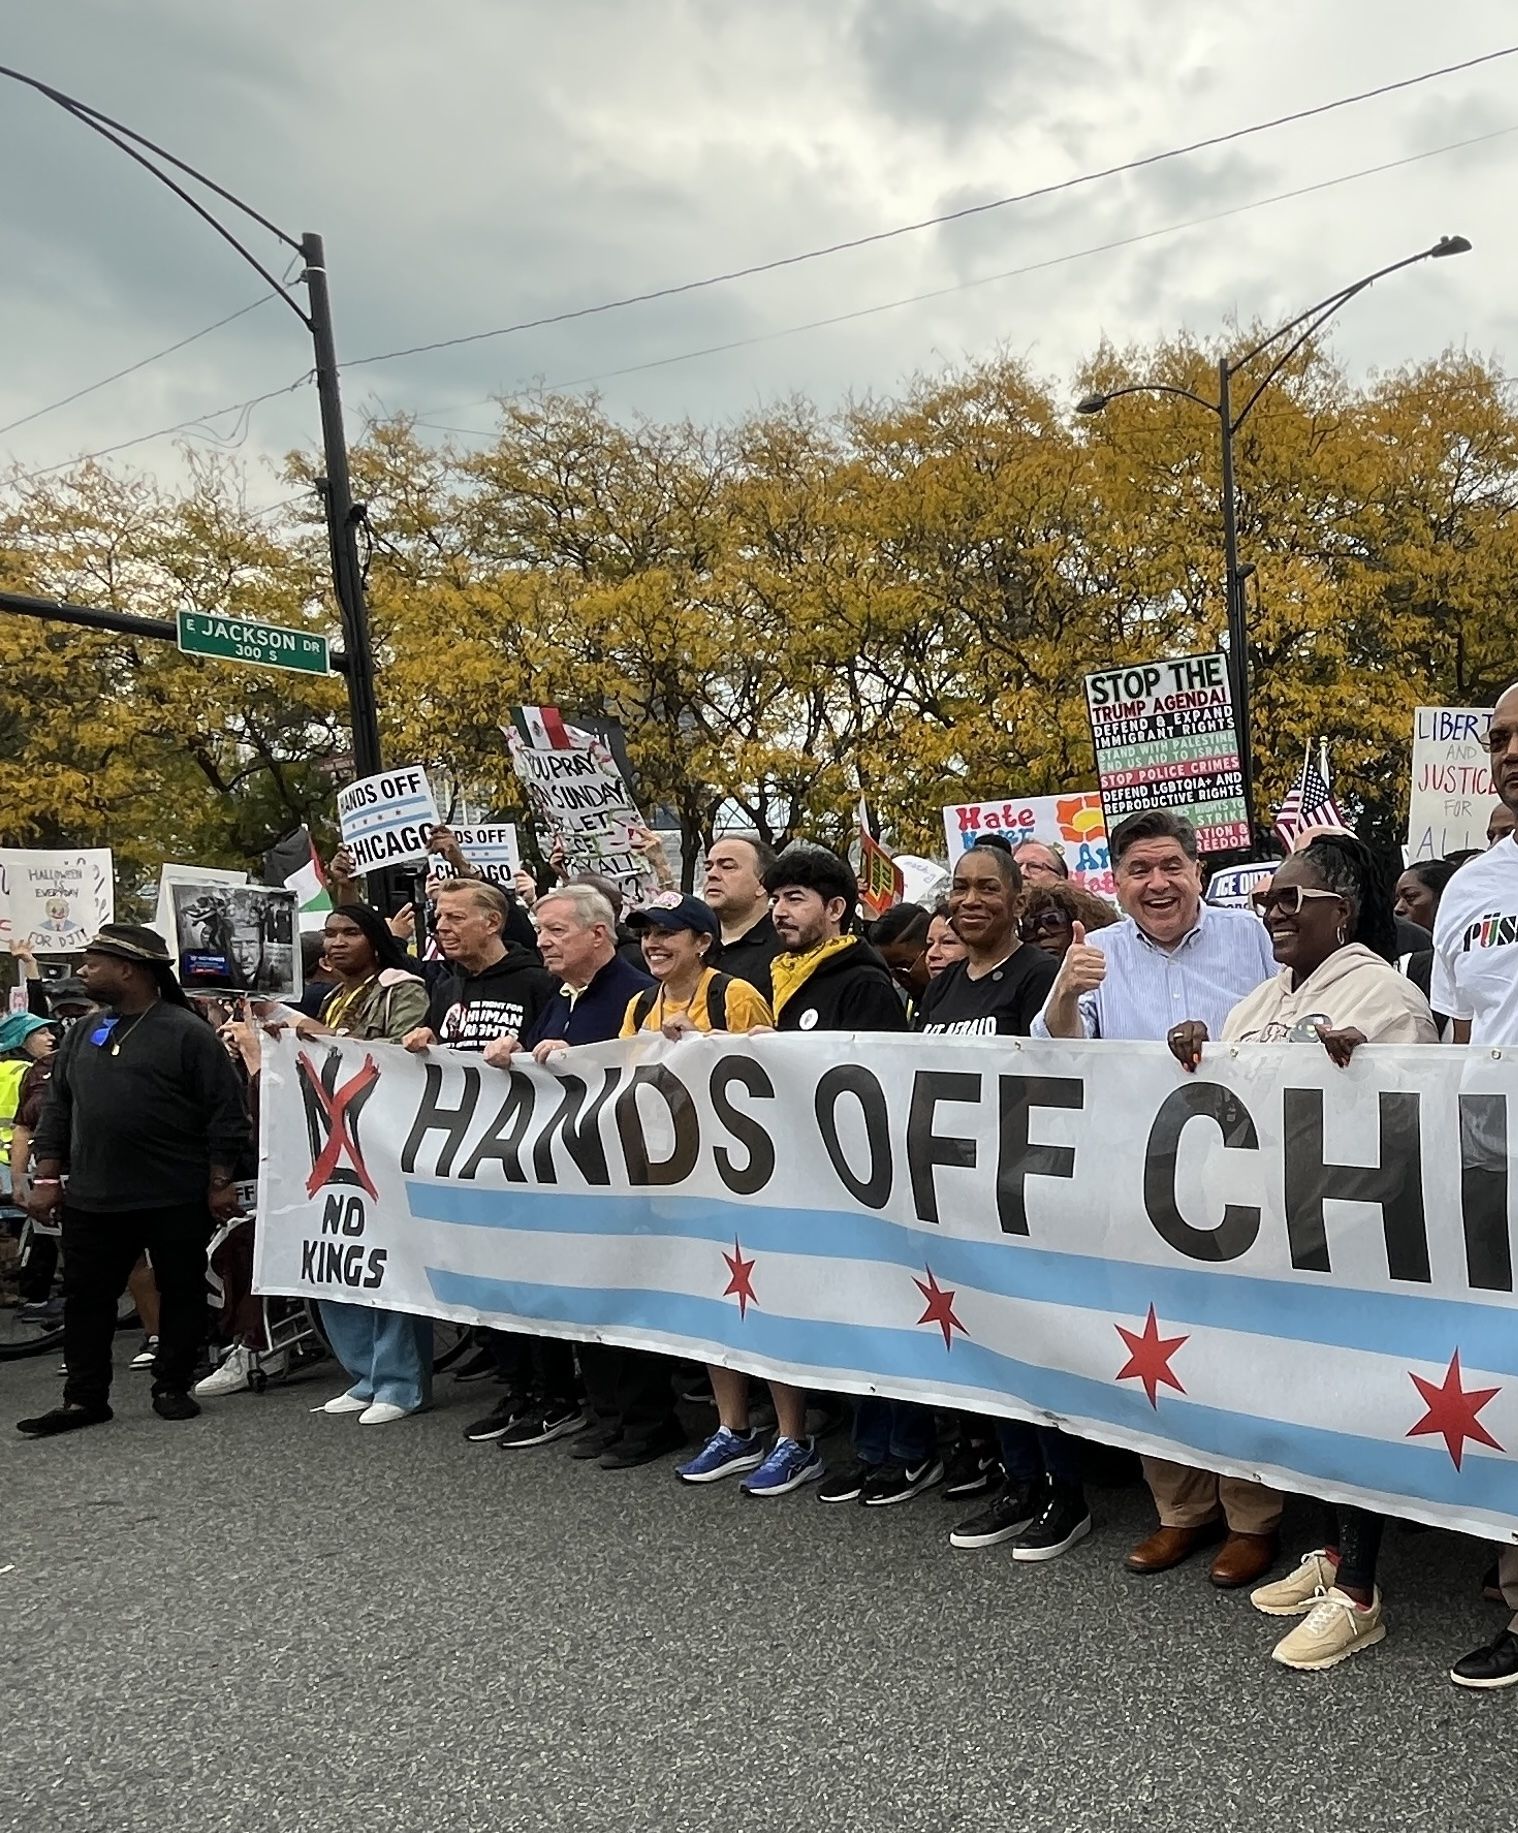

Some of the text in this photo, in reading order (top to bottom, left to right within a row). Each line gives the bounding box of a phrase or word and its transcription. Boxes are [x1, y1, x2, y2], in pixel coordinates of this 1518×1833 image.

[186, 618, 321, 653] E JACKSON DR
[235, 643, 278, 662] 300 S
[1090, 657, 1224, 705] STOP THE
[1092, 687, 1227, 723] TRUMP AGENDA!
[1093, 705, 1233, 738] DEFEND & EXPAND
[1094, 717, 1235, 749] IMMIGRANT RIGHTS
[1418, 711, 1493, 742] LIBERT
[1097, 732, 1235, 762] STAND WITH PALESTINE
[1099, 744, 1238, 773] END US AID TO ISRAEL
[1446, 743, 1477, 760] AND
[547, 751, 598, 779] PRAY
[1101, 756, 1240, 788] STOP POLICE CRIMES
[380, 772, 421, 799] OFF
[551, 779, 626, 810] SUNDAY
[1102, 771, 1243, 803] DEFEND LGBTQIA+ AND
[1104, 791, 1195, 815] REPRODUCTIVE
[1198, 784, 1244, 804] RIGHTS
[1231, 799, 1246, 810] TO
[1443, 799, 1473, 817] FOR
[570, 810, 610, 833] LET
[956, 804, 1036, 831] Hate
[1197, 810, 1246, 826] STRIKE
[476, 829, 507, 844] OFF
[1195, 834, 1250, 851] REEDOM
[435, 864, 512, 882] CHAGO
[599, 853, 642, 878] ALL
[1215, 873, 1237, 897] ICE
[466, 1009, 524, 1027] HUMAN
[506, 1003, 524, 1013] FOR
[463, 1023, 520, 1041] RIGHTS
[400, 1053, 776, 1196] HANDS
[814, 1063, 1085, 1238] OFF
[322, 1193, 365, 1238] NO
[301, 1239, 388, 1290] KINGS
